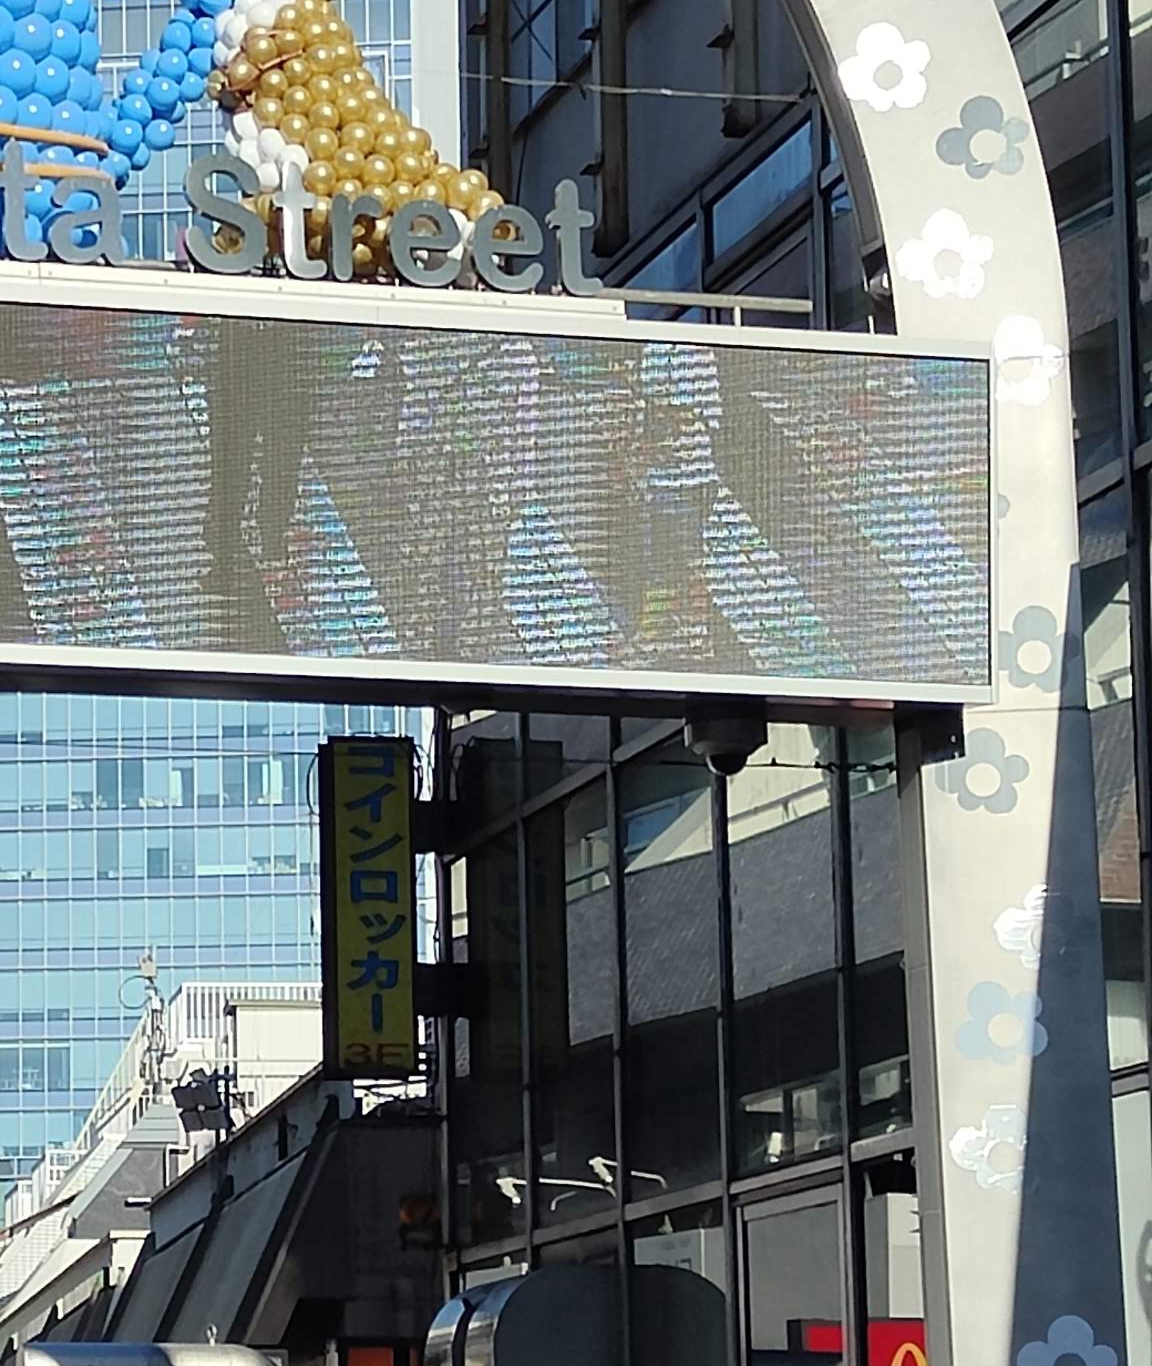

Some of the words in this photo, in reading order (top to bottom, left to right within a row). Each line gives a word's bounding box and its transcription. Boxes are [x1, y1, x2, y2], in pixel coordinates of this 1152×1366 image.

[184, 154, 605, 296] Street
[345, 745, 408, 1035] コインロッカー
